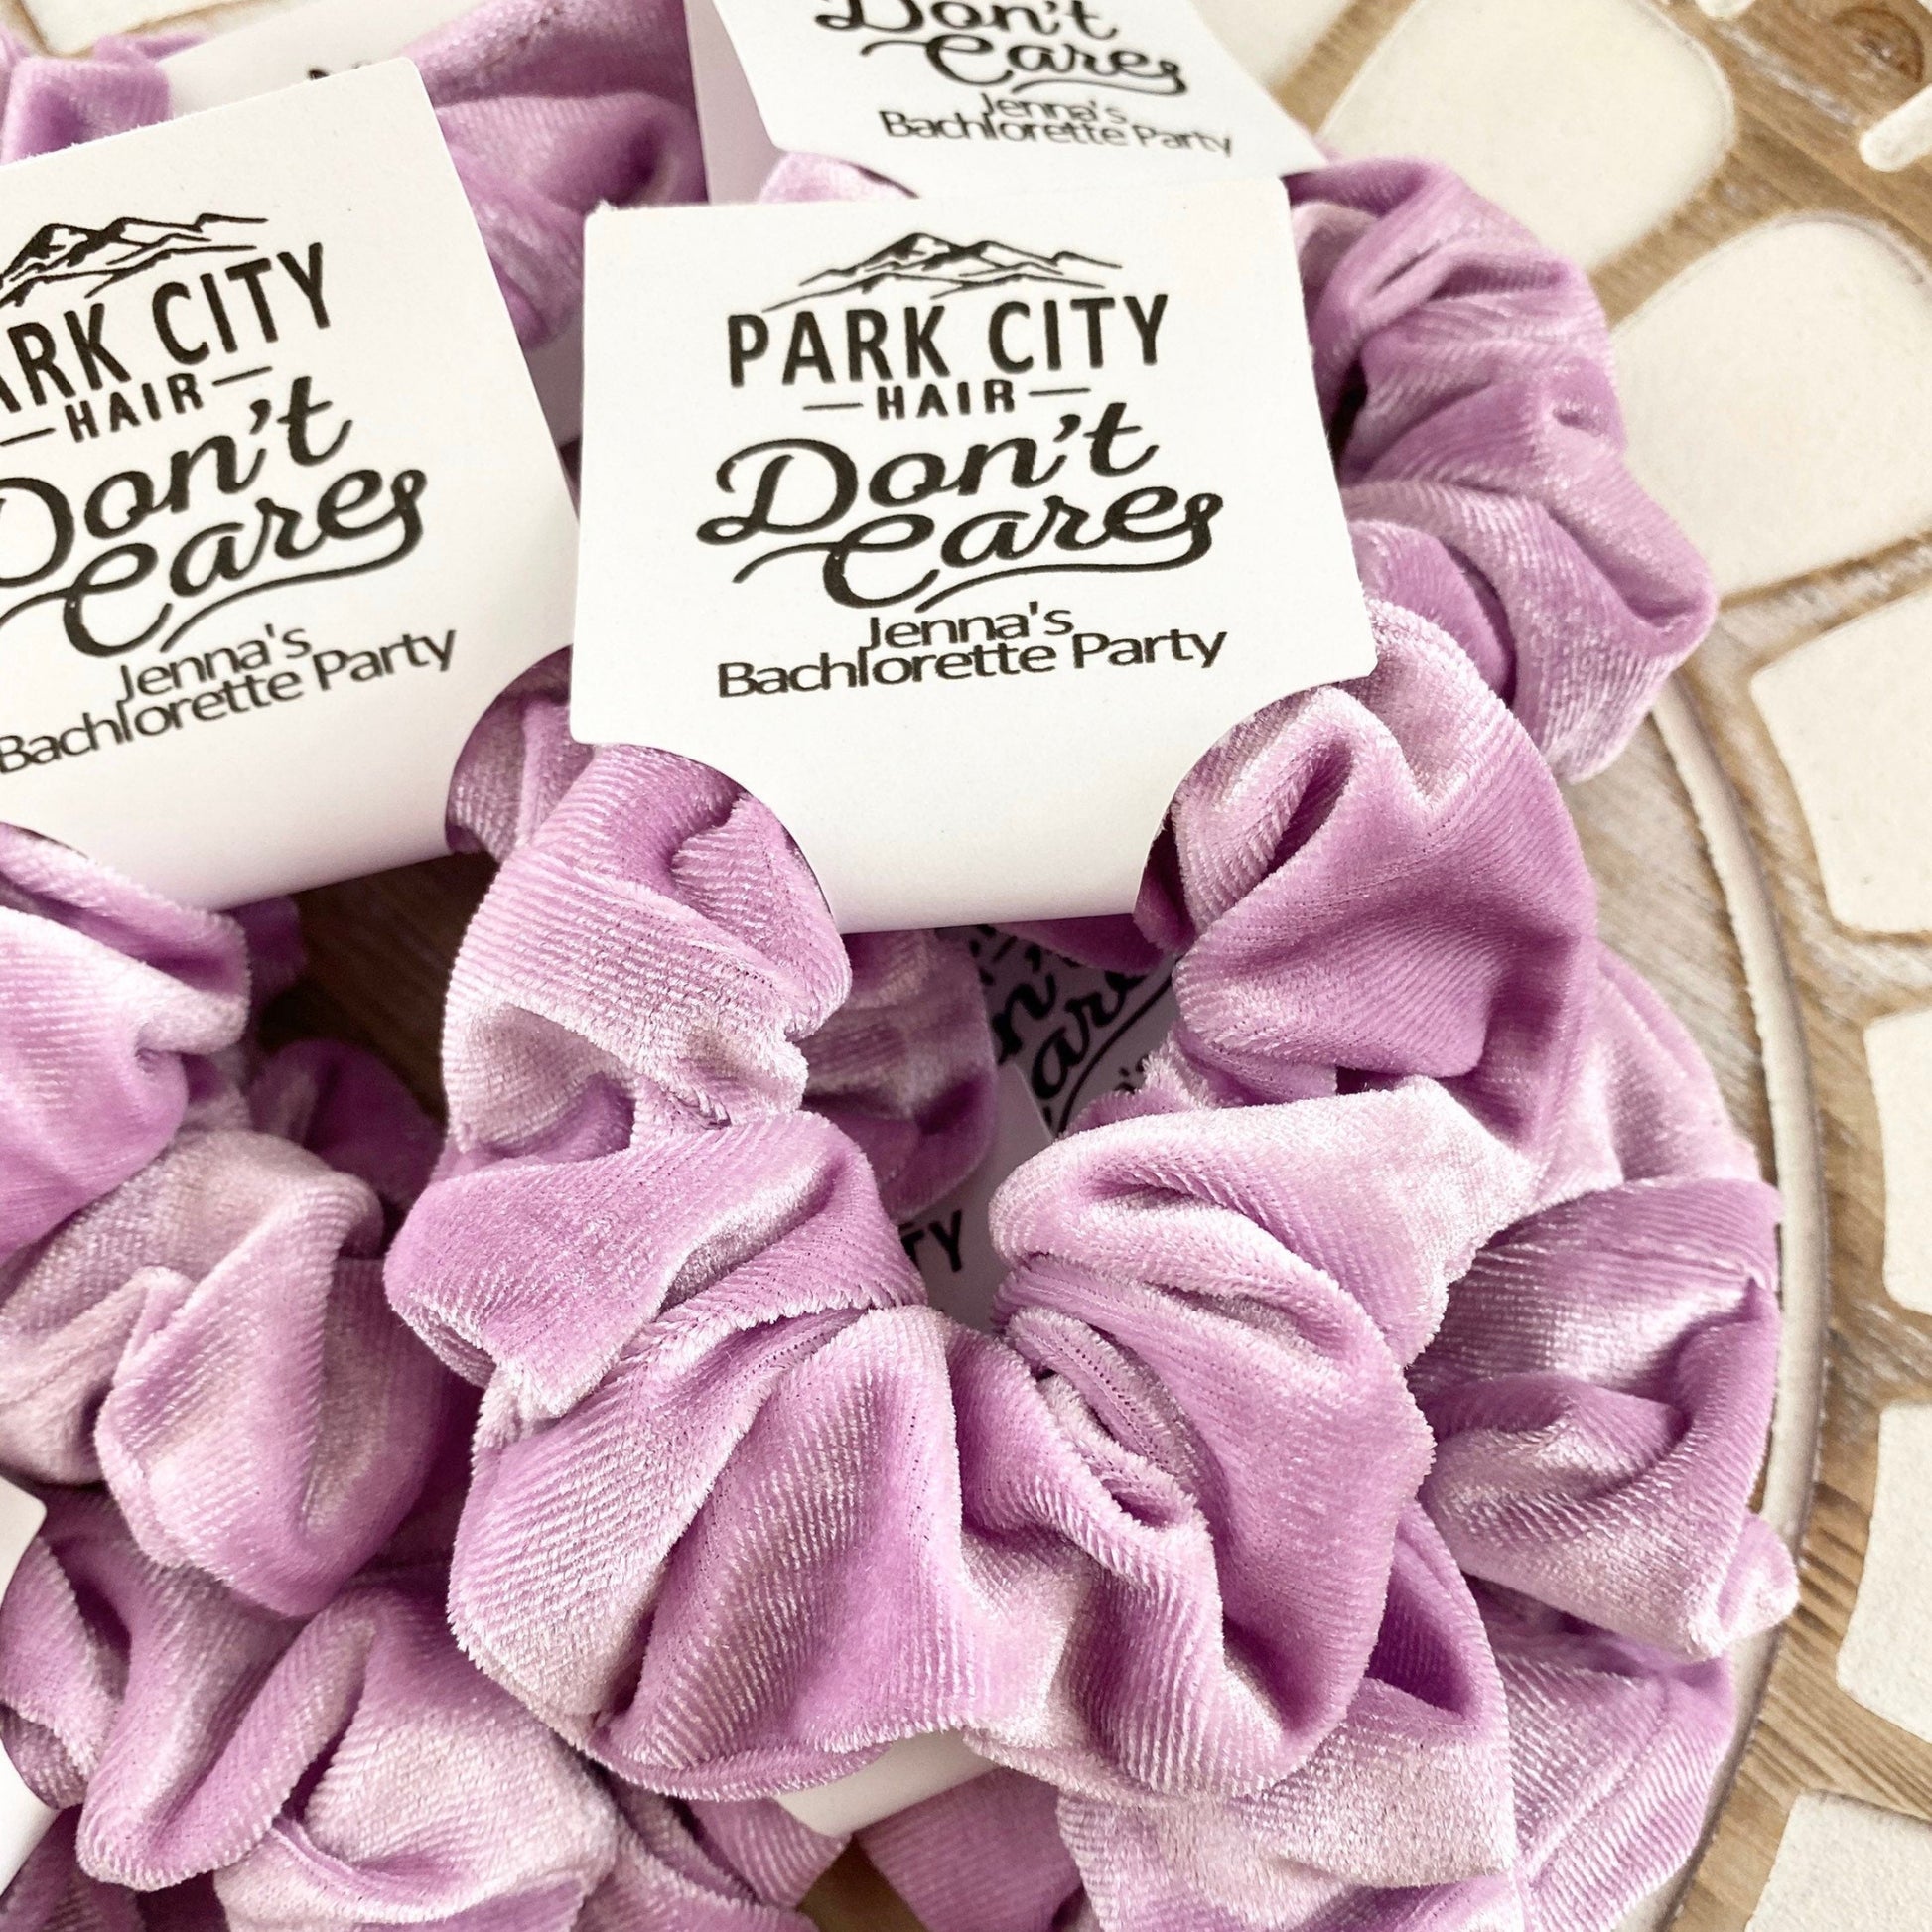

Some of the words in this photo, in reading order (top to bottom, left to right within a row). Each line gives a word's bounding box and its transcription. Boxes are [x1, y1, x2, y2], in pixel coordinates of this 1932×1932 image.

[879, 110, 1129, 146] Bachlorette
[1131, 124, 1234, 157] Party
[980, 93, 1128, 126] Jenna's
[151, 241, 331, 366] CITY
[727, 303, 952, 388] PARK
[988, 292, 1170, 373] CITY
[64, 372, 204, 443] HAIR
[876, 377, 1017, 421] HAIR
[695, 401, 1161, 546] Don't
[864, 600, 1075, 652] Jenna's
[115, 623, 312, 701] Jenna's
[717, 641, 1058, 698] Bachlorette
[1072, 627, 1228, 670] Party
[0, 668, 304, 774] Bachlorette
[311, 629, 457, 691] Party
